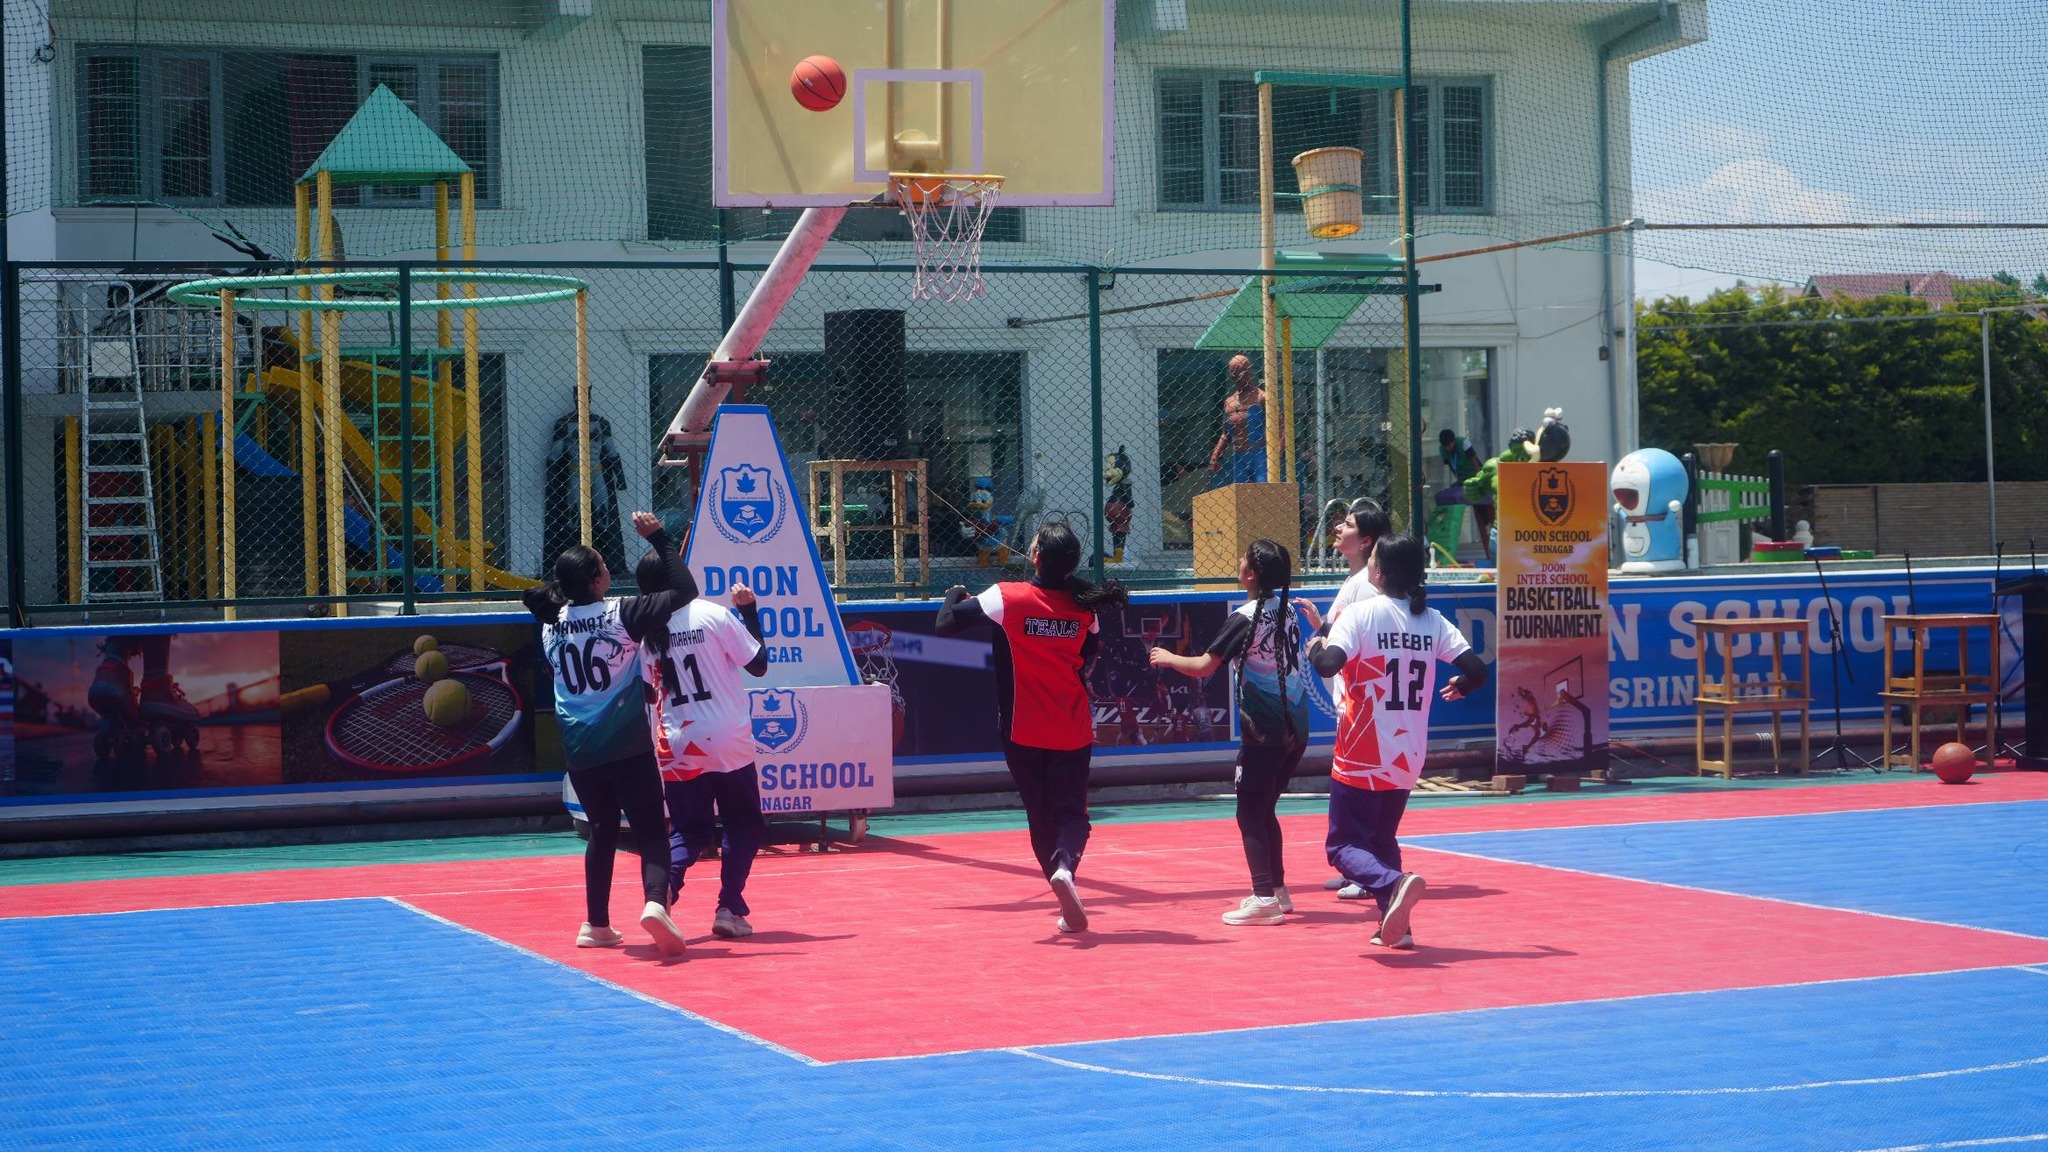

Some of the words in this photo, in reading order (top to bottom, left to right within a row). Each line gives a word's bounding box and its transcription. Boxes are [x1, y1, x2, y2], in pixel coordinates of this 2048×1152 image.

[1515, 530, 1547, 542] DOON
[1549, 530, 1592, 542] SCHOOL
[1533, 545, 1574, 554] SRINAGAR
[1517, 573, 1547, 585] INTER
[1550, 573, 1590, 585] SCHOOL
[1542, 563, 1566, 573] DOON
[703, 565, 798, 597] DOON
[1506, 586, 1600, 611] BASKETBALL
[1024, 617, 1080, 638] TEALS
[1504, 613, 1602, 639] TOURNAMENT
[558, 635, 612, 695] 06
[667, 653, 713, 707] 11
[1385, 657, 1427, 711] 12
[761, 762, 874, 791] SCHOOL
